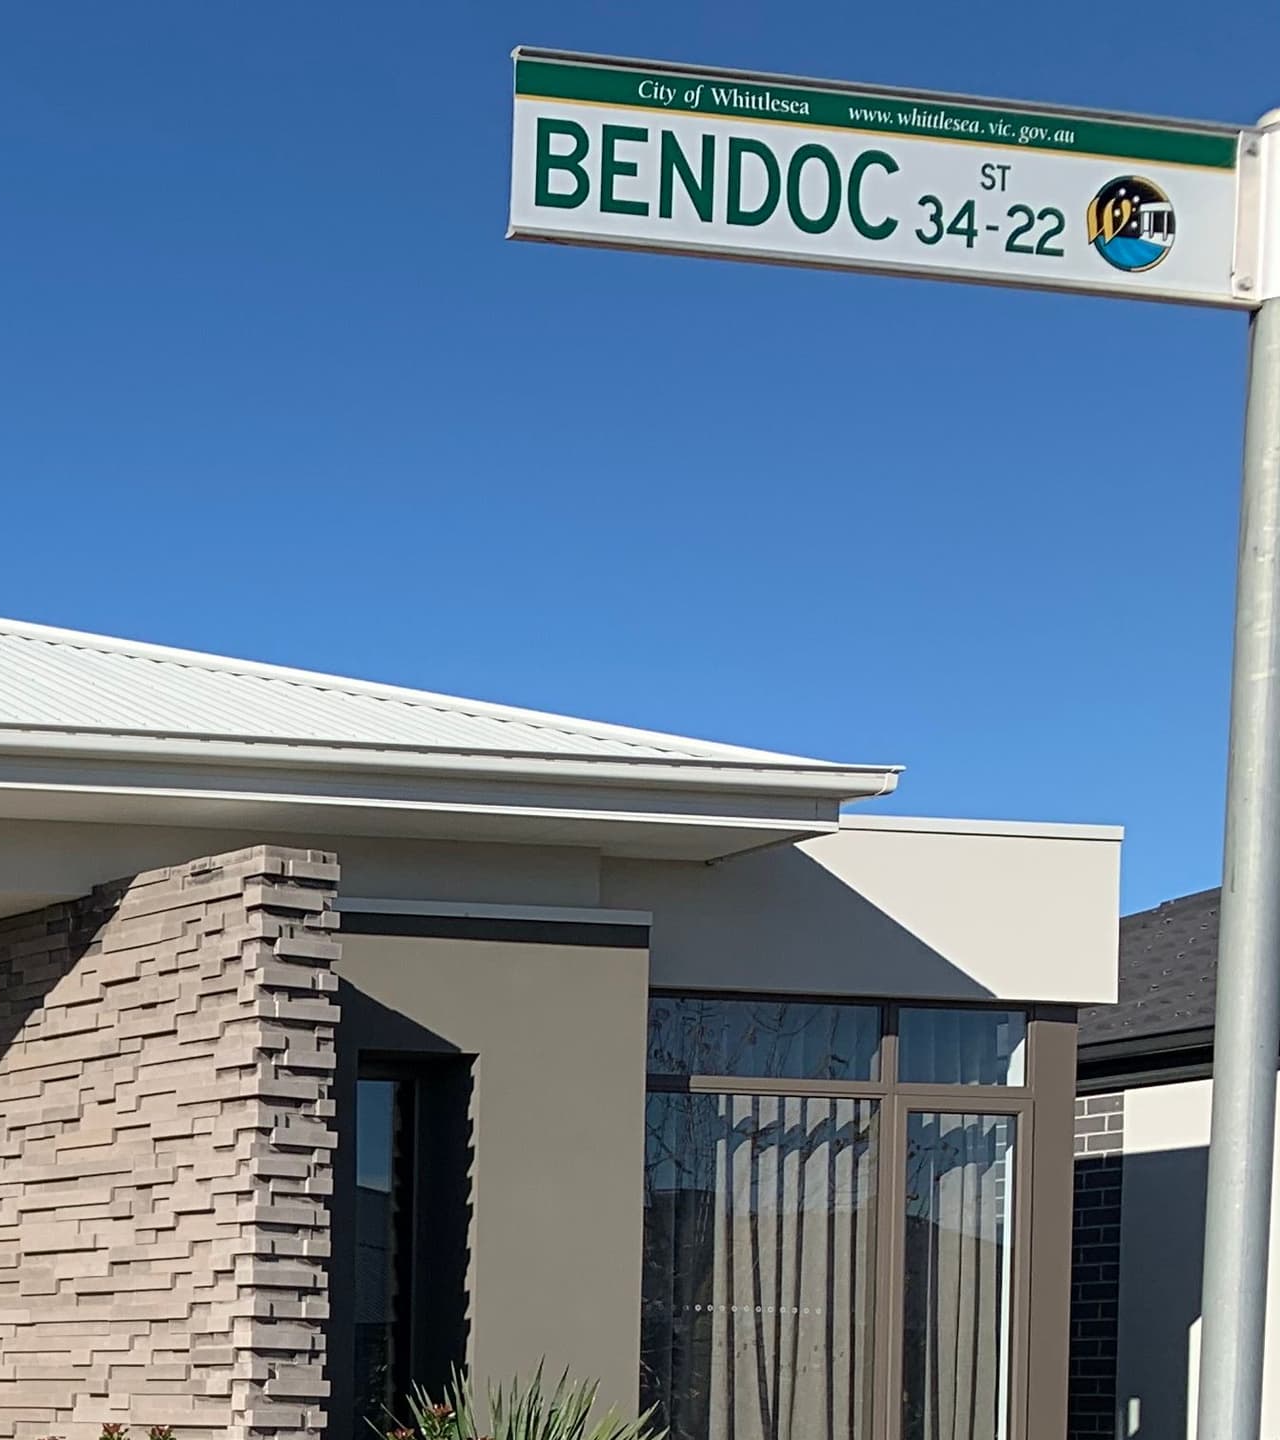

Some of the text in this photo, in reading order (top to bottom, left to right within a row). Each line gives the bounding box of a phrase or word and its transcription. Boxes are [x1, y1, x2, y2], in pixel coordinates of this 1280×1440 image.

[638, 79, 811, 116] City of Whittlesea
[534, 116, 900, 241] BENDOC
[980, 163, 1012, 192] ST
[914, 194, 1066, 258] 34-22
